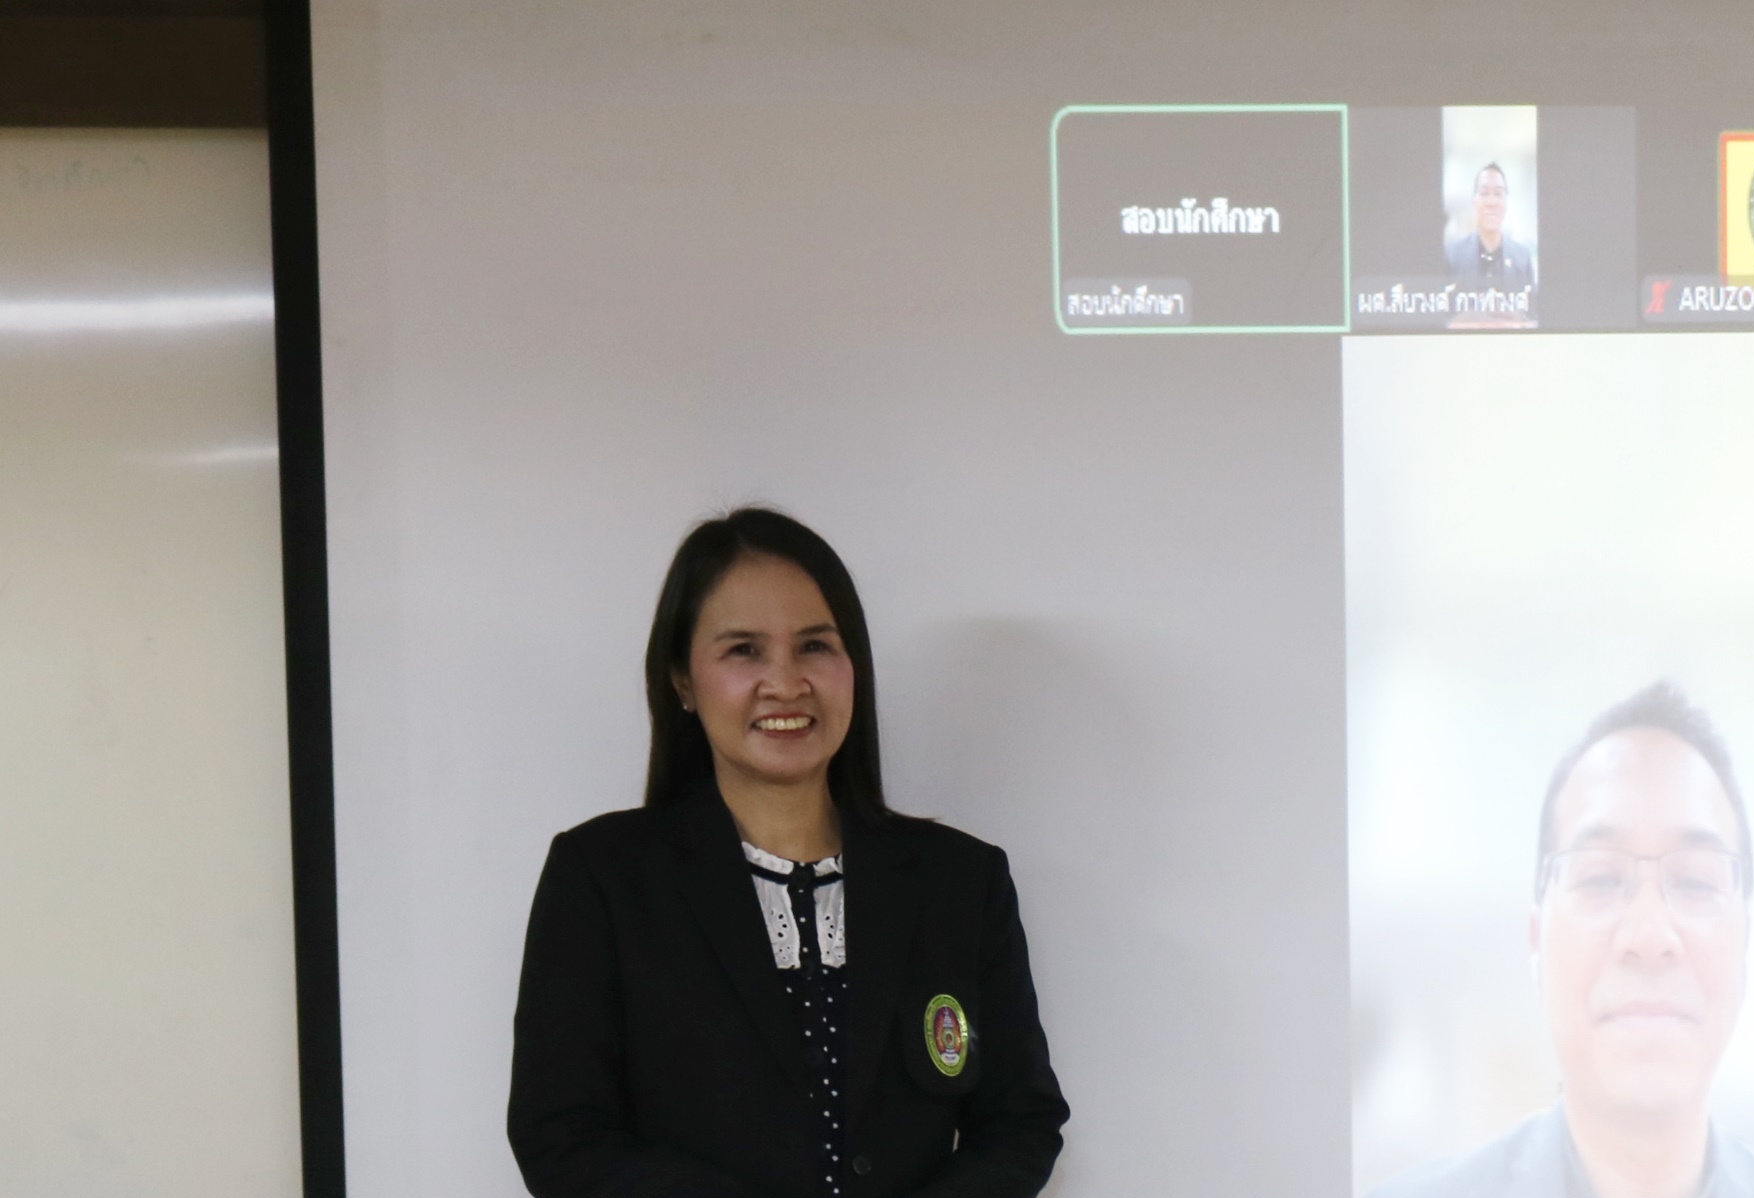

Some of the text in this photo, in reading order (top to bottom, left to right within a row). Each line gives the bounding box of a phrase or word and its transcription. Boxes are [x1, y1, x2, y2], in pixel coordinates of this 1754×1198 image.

[1120, 197, 1280, 234] สอบนักศึกษา
[1067, 284, 1185, 315] สอบนักศึกษา
